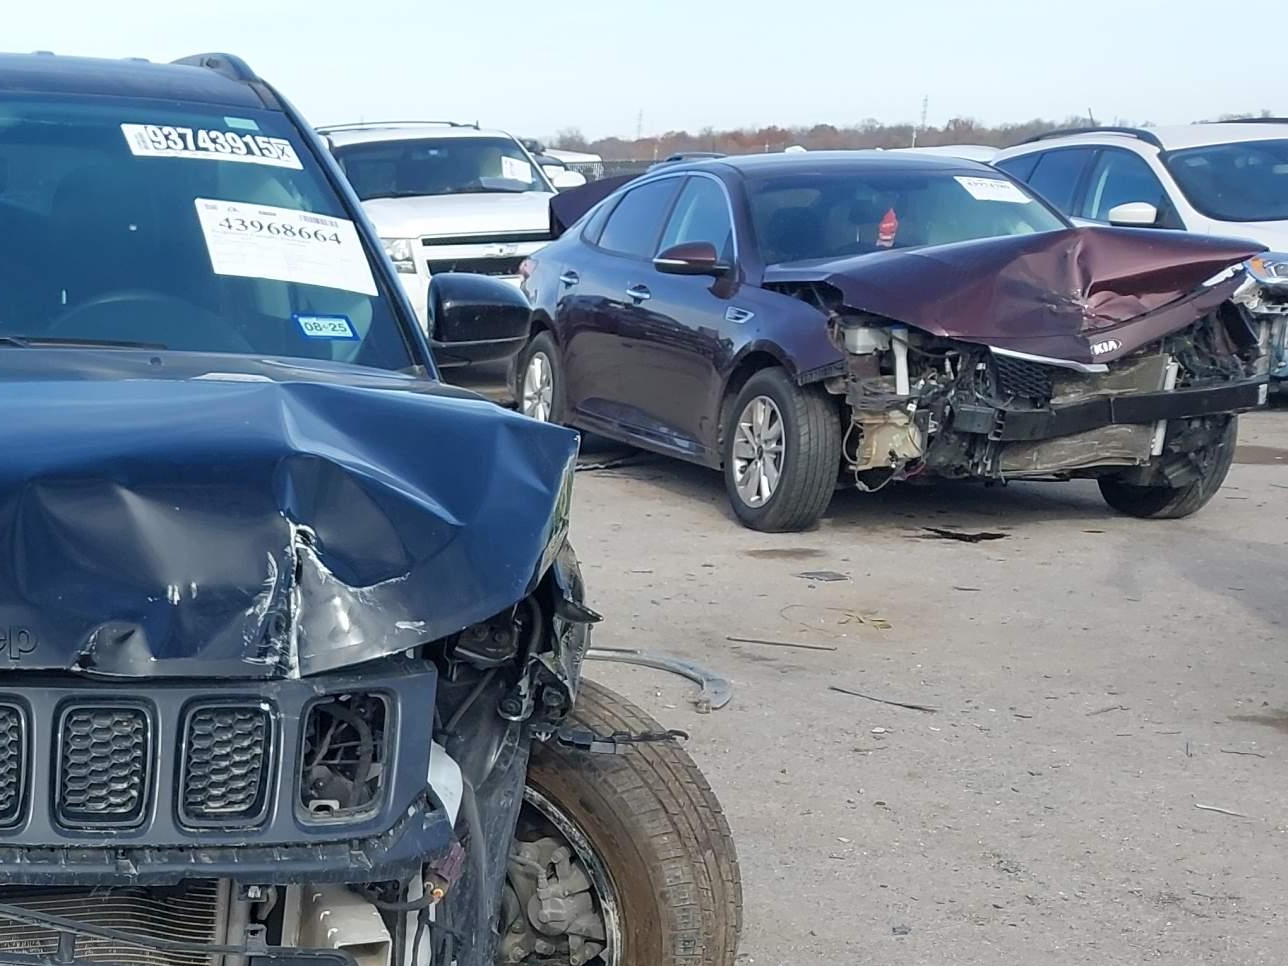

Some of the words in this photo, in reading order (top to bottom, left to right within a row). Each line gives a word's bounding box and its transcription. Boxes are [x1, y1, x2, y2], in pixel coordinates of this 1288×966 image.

[147, 125, 278, 158] 93743915
[218, 217, 343, 245] 43968664
[1092, 340, 1119, 356] KIA
